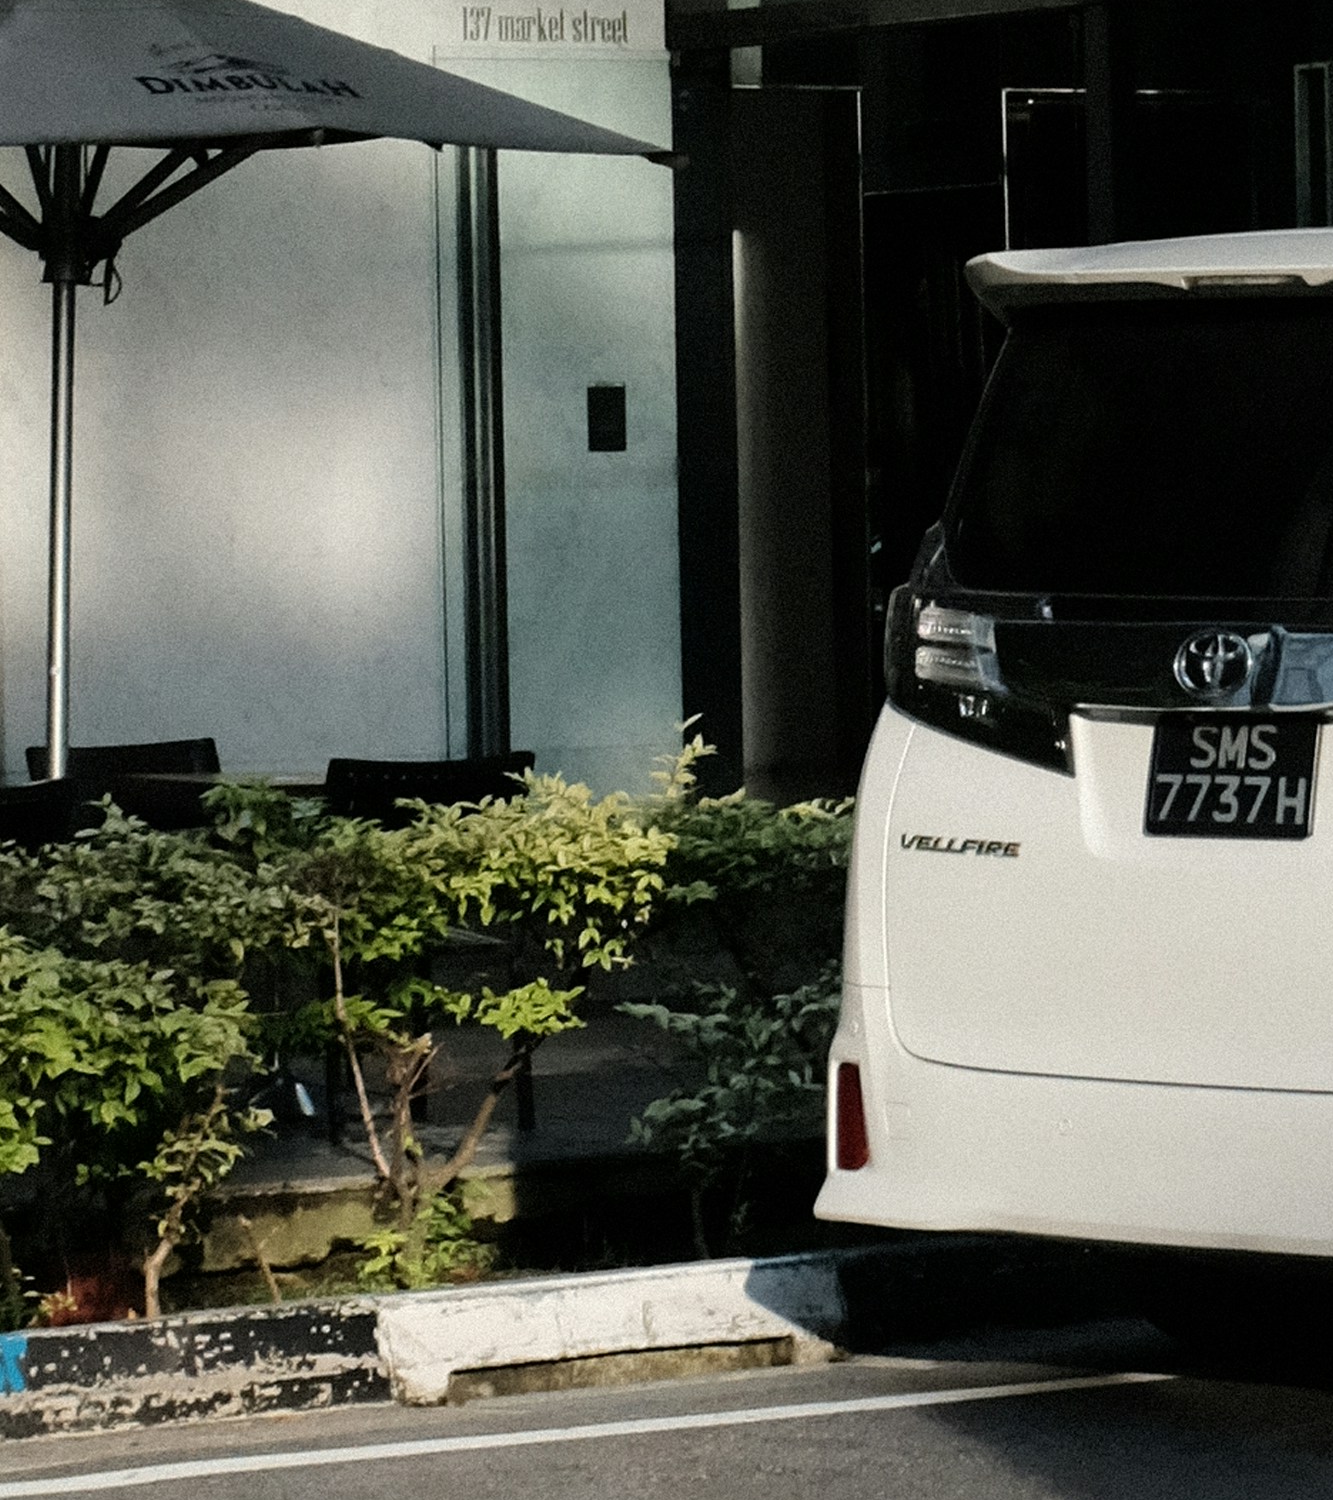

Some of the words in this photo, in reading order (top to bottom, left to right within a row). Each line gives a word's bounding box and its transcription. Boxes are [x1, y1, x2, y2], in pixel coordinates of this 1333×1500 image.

[463, 6, 491, 41] 137
[498, 7, 564, 43] market
[572, 9, 628, 44] street
[134, 75, 363, 99] DIMBULAH
[1190, 724, 1278, 770] SMS
[1156, 773, 1307, 825] 7737H
[900, 833, 1020, 858] VELLFIRE
